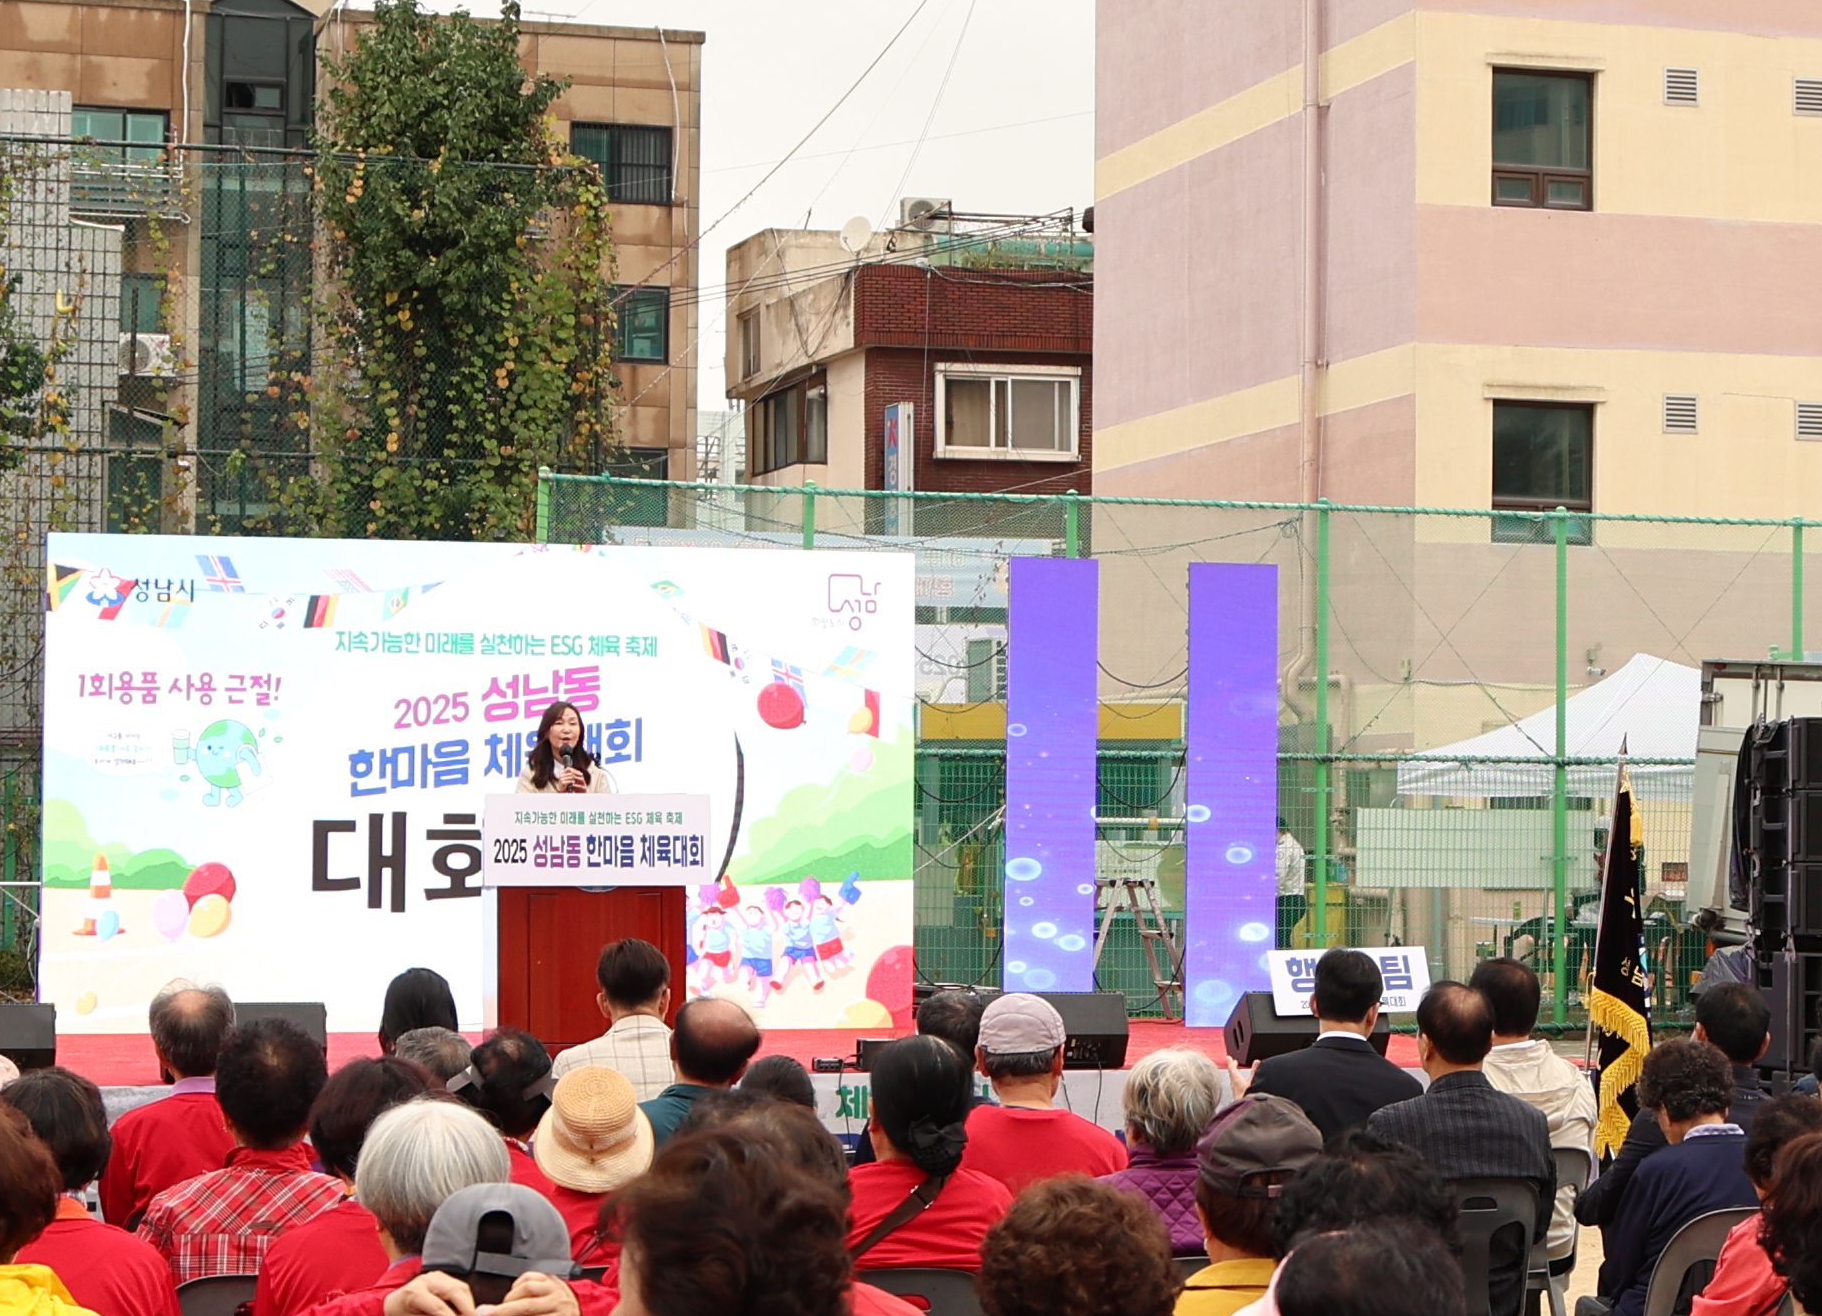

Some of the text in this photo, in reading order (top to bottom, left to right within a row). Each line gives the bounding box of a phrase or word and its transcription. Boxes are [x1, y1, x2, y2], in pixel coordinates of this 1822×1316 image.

[132, 578, 194, 603] 성남시
[335, 631, 658, 657] 지속가능한 미래를 실천하는 ESG 체육 축제
[78, 671, 282, 706] 1회용품 사용 근절!
[394, 665, 600, 729] 2025 성남동
[348, 717, 643, 798] 한마음 체회
[514, 811, 683, 825] 지속가능한 미래를 실천하는 ESG 체육 축제
[493, 834, 704, 868] 2025 성남동 한마음 체육대회
